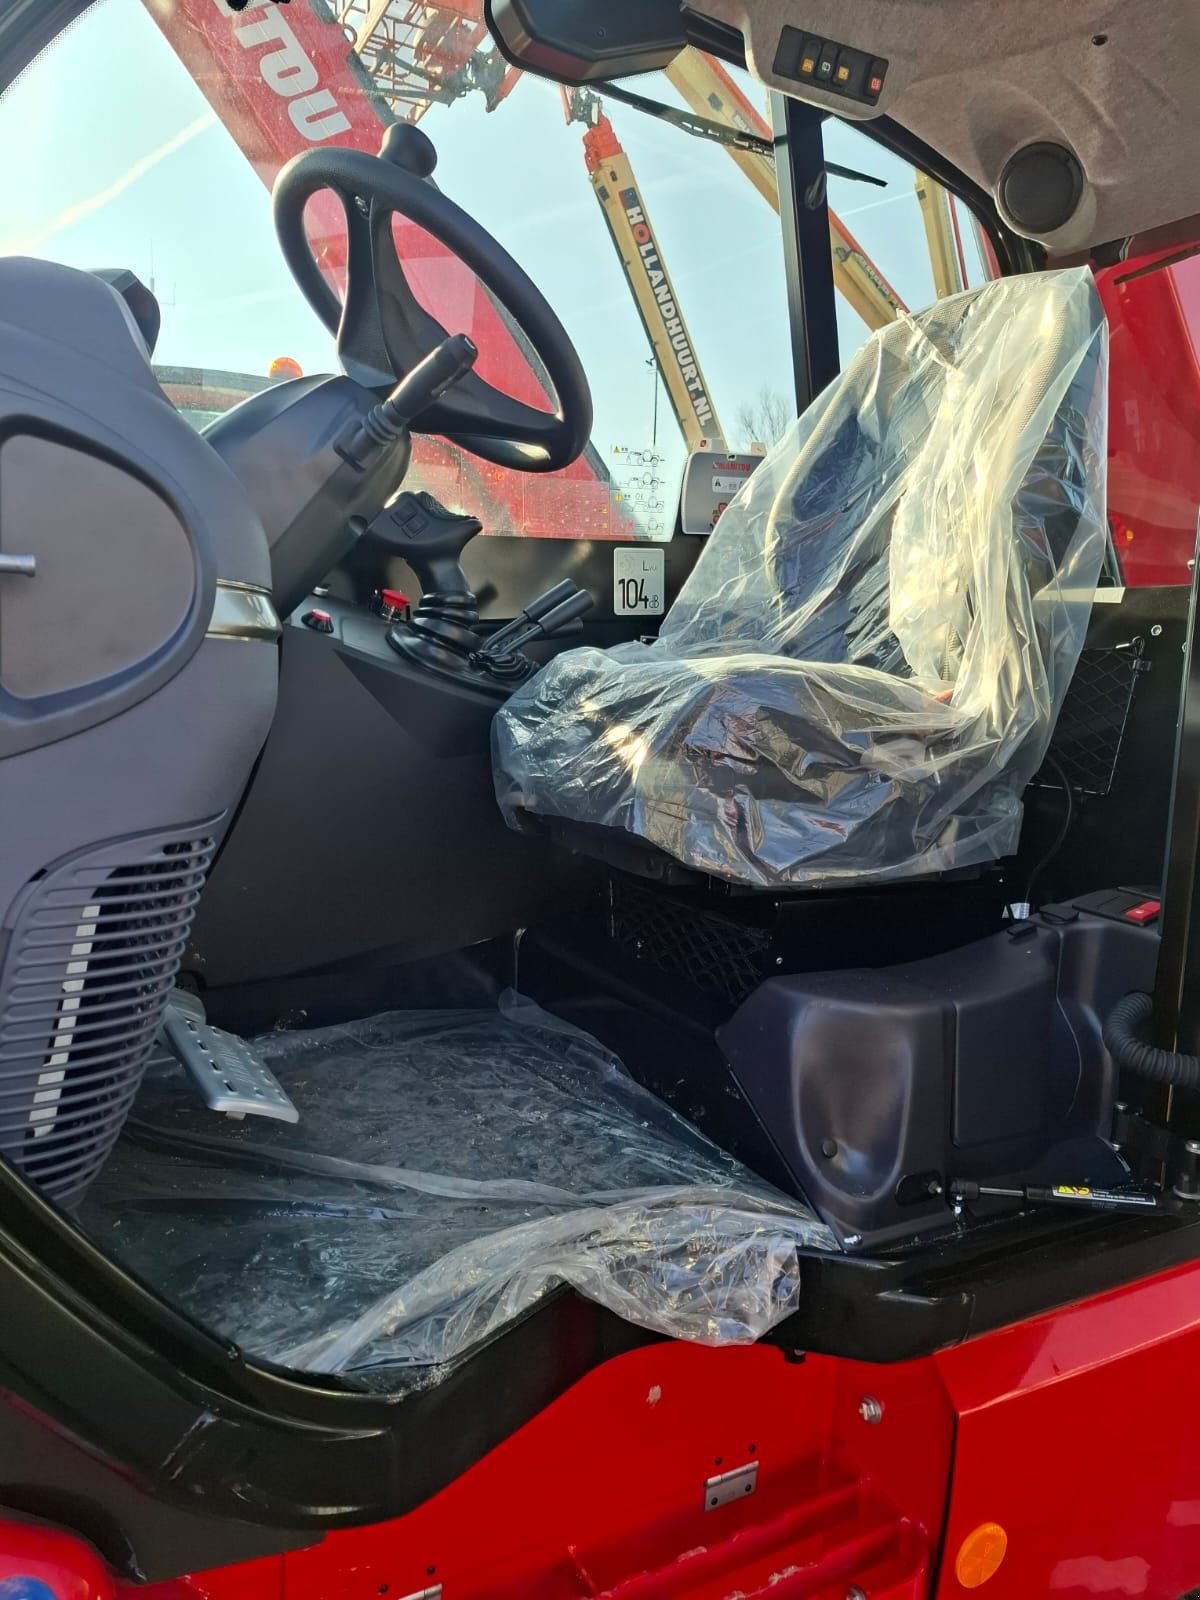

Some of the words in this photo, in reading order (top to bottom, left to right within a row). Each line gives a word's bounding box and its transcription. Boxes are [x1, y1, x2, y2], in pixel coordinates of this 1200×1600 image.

[213, 0, 352, 141] TOU
[626, 205, 713, 427] HOLLANDHUURT.NL
[618, 578, 649, 609] 104
